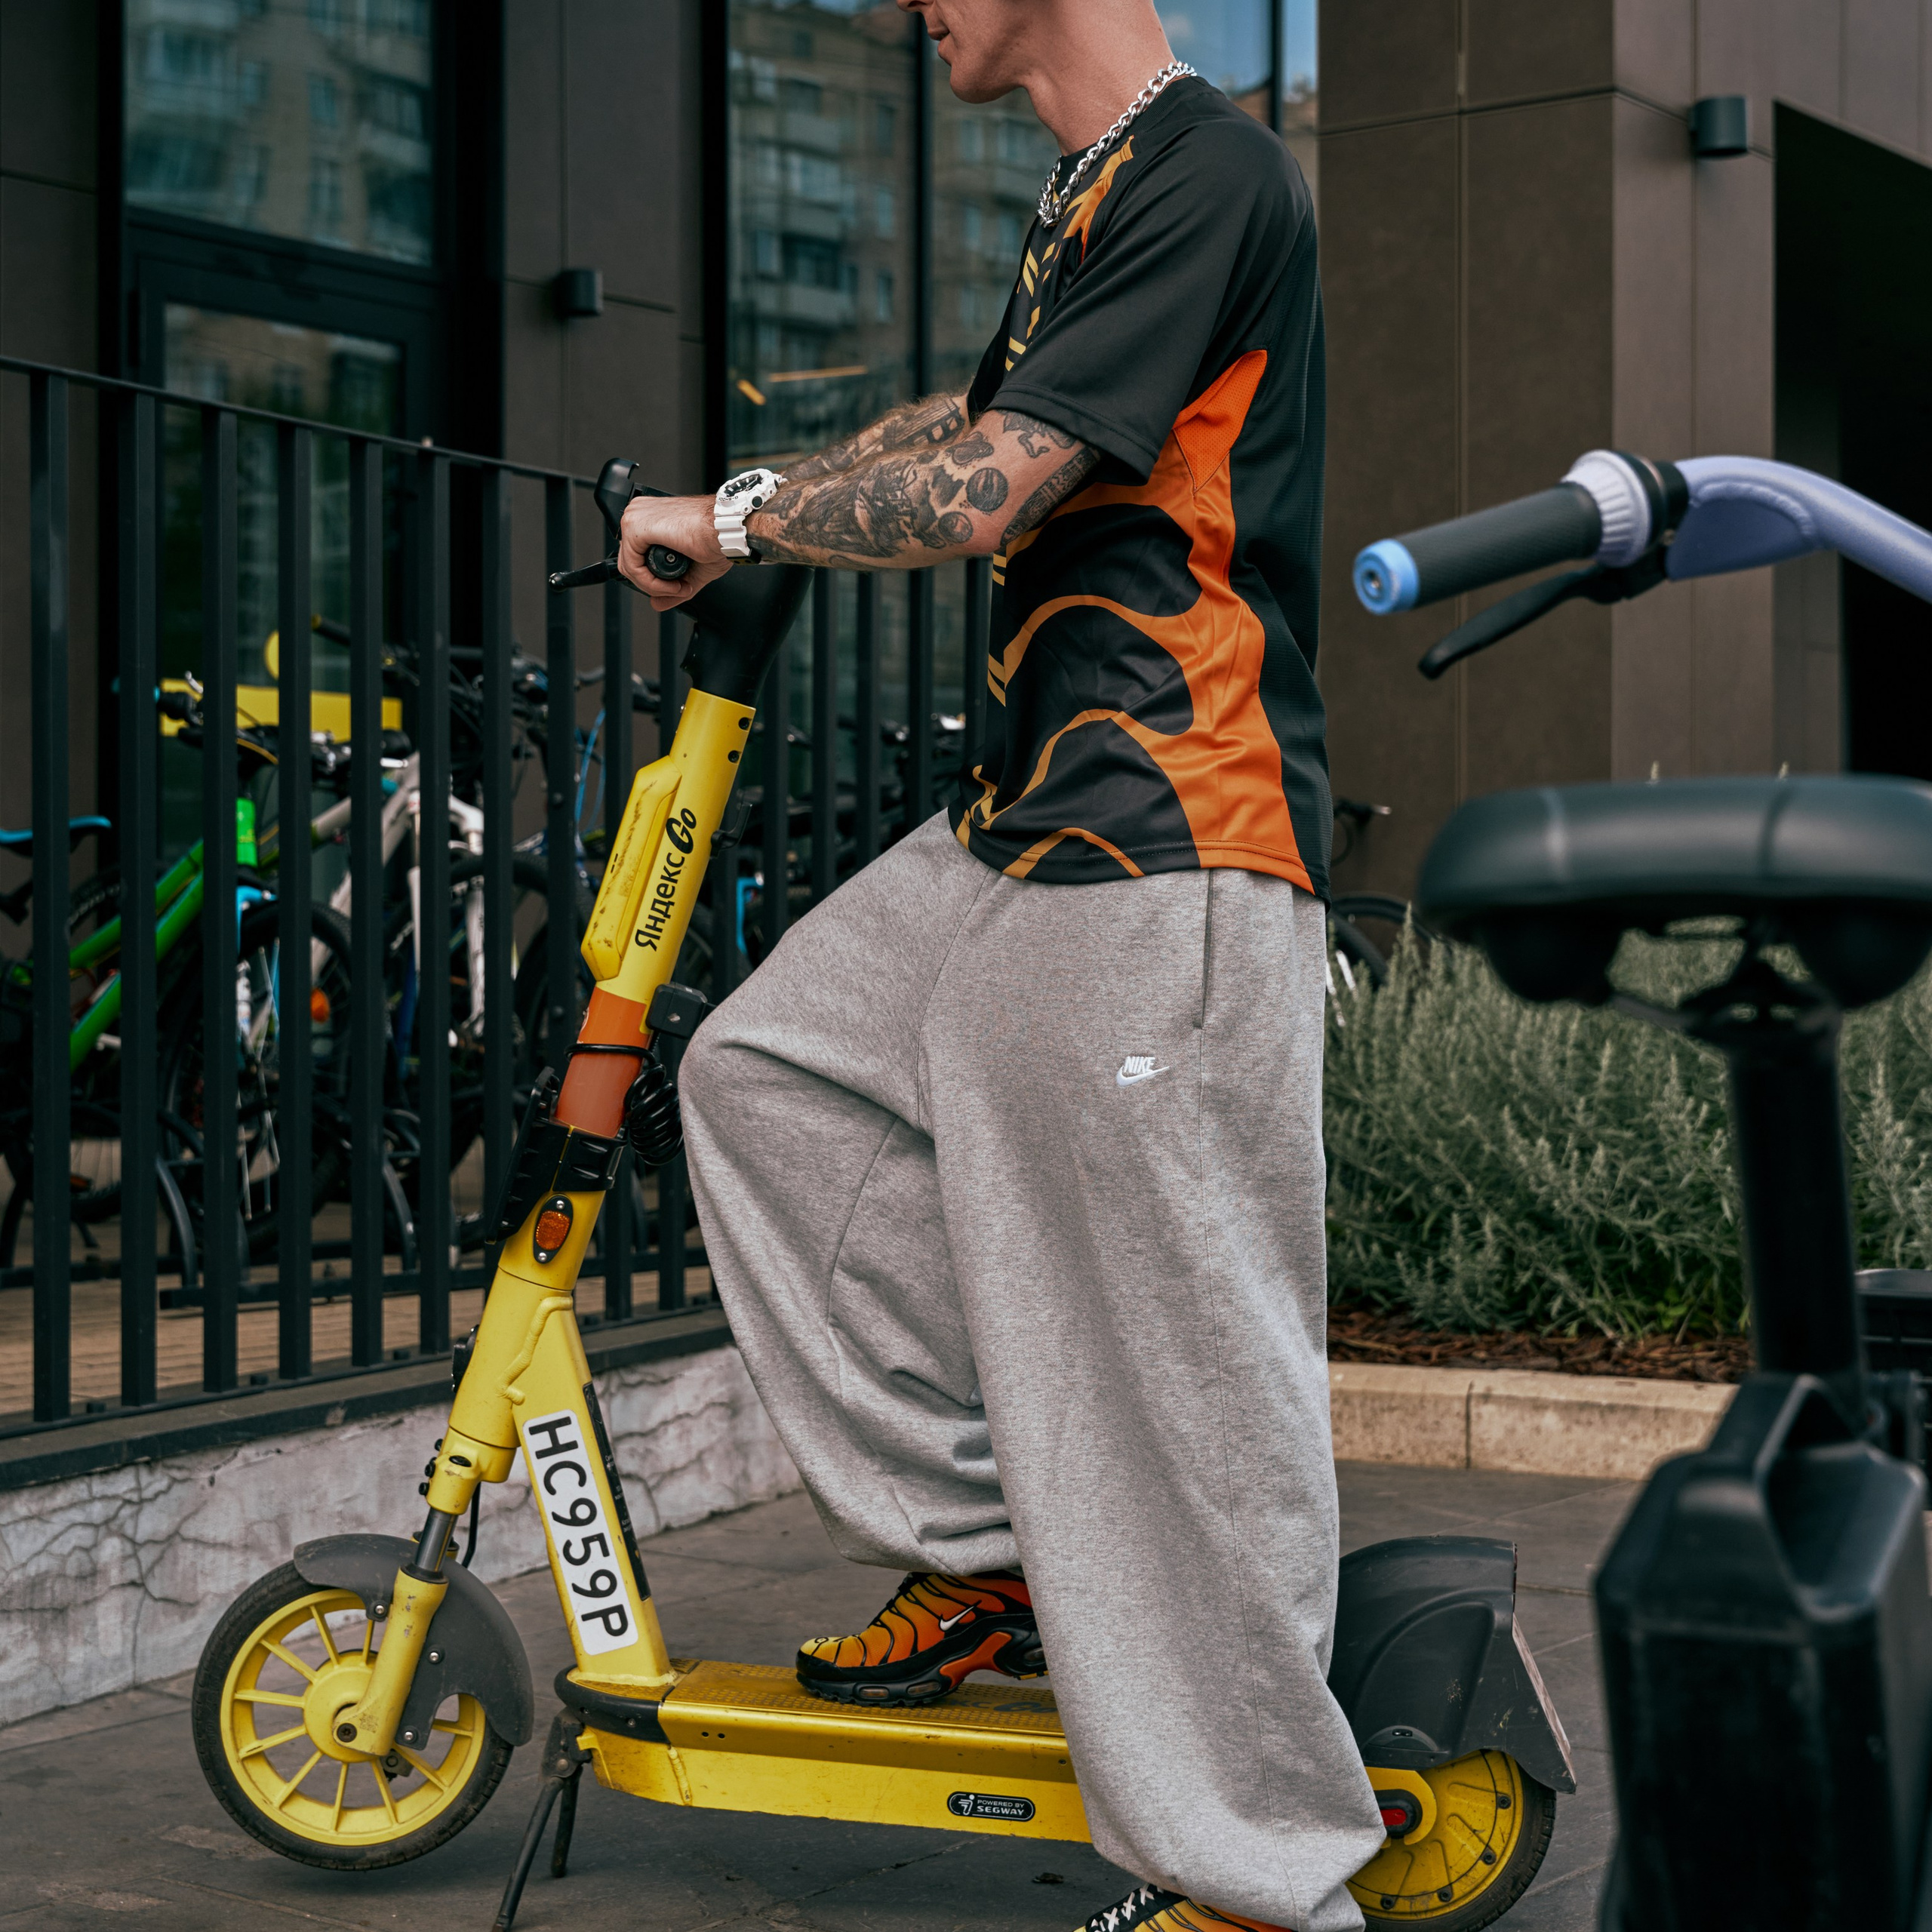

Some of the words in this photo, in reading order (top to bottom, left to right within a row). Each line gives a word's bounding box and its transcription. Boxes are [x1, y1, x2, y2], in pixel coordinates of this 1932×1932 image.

[635, 853, 685, 952] Яндекс
[666, 808, 697, 854] Go
[1124, 1056, 1155, 1074] NIKE
[977, 1799, 1013, 1807] POWERED
[977, 1805, 1024, 1816] SEGWAY
